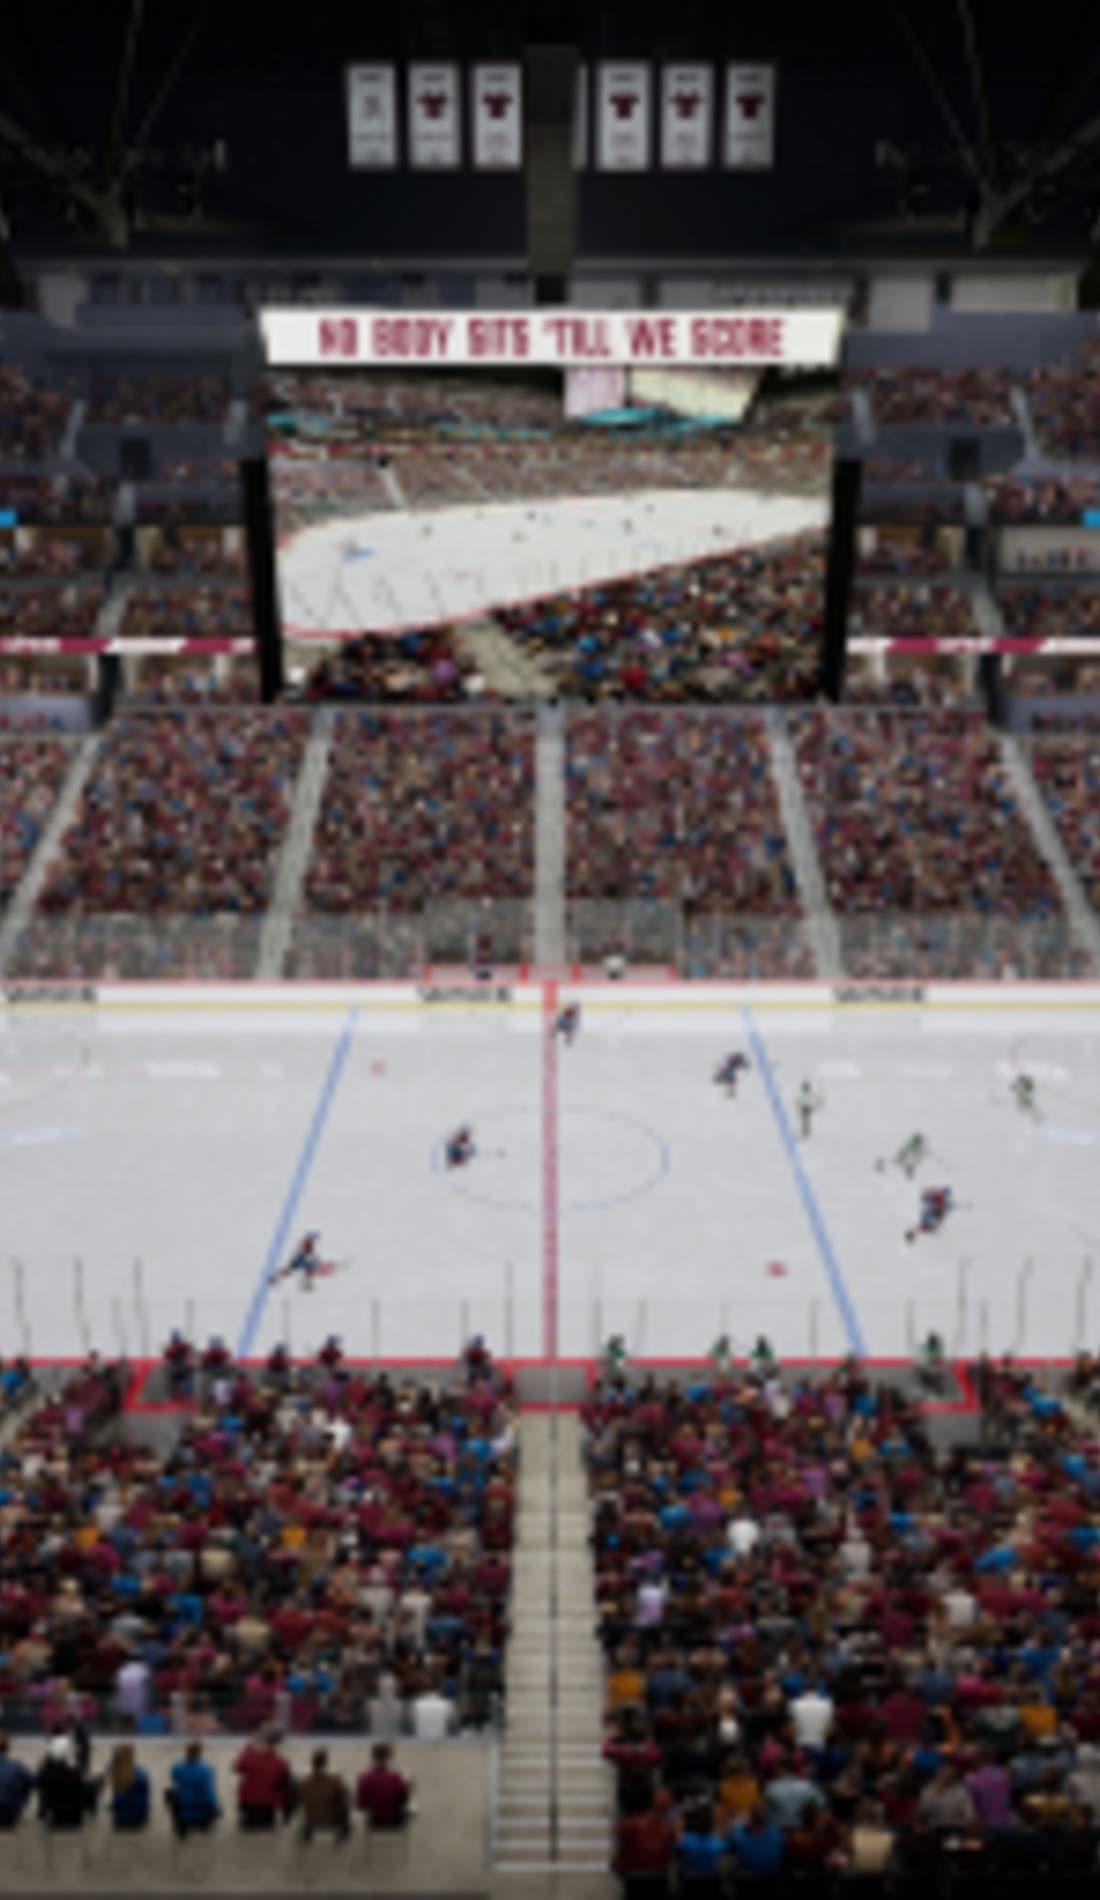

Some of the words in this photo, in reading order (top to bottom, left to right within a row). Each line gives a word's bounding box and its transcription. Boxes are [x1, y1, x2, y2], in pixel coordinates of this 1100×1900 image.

[319, 318, 358, 357] NO
[372, 318, 452, 357] BODY
[468, 318, 529, 357] SITS
[628, 318, 676, 357] WE
[691, 318, 783, 357] SCORE
